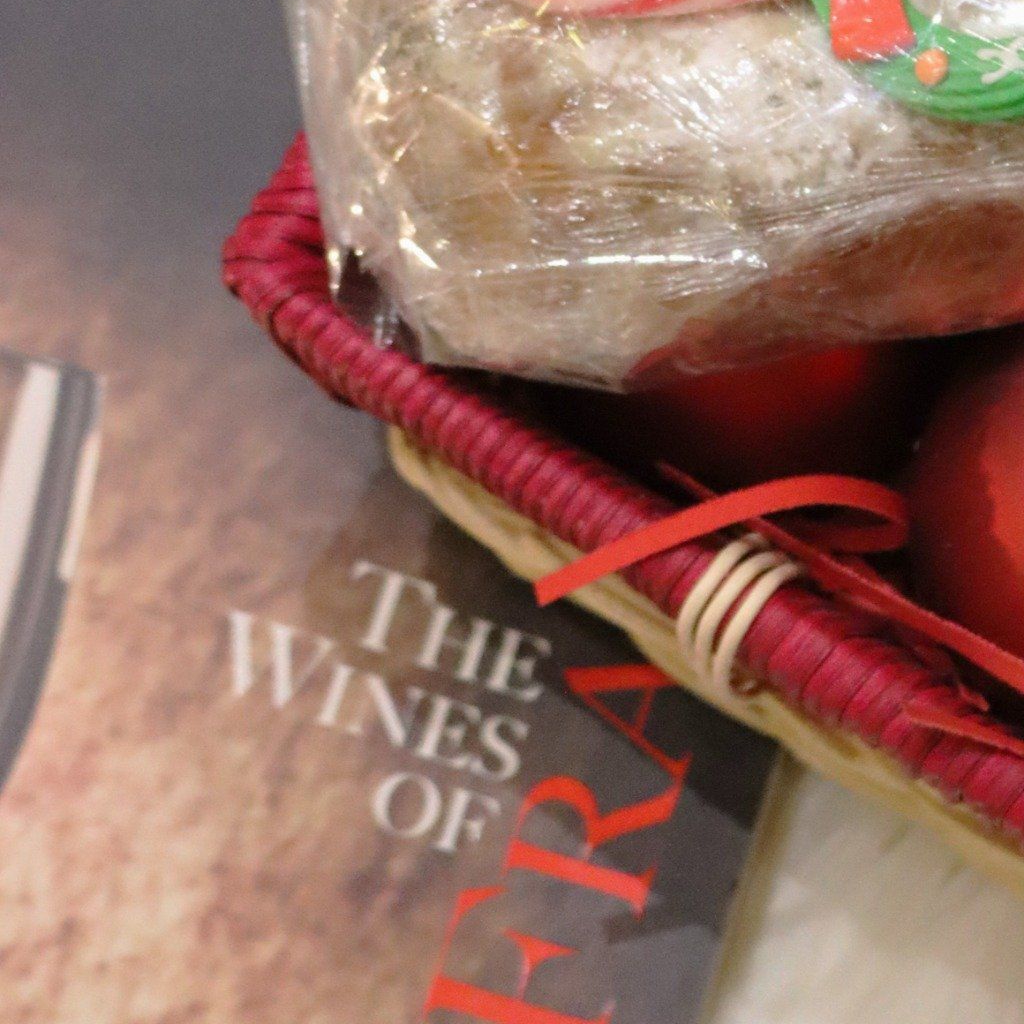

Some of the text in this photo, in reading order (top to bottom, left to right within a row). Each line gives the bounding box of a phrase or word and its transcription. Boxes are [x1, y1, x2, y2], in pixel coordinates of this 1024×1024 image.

[227, 610, 530, 781] WINES
[351, 561, 552, 703] THE
[370, 771, 501, 854] OF
